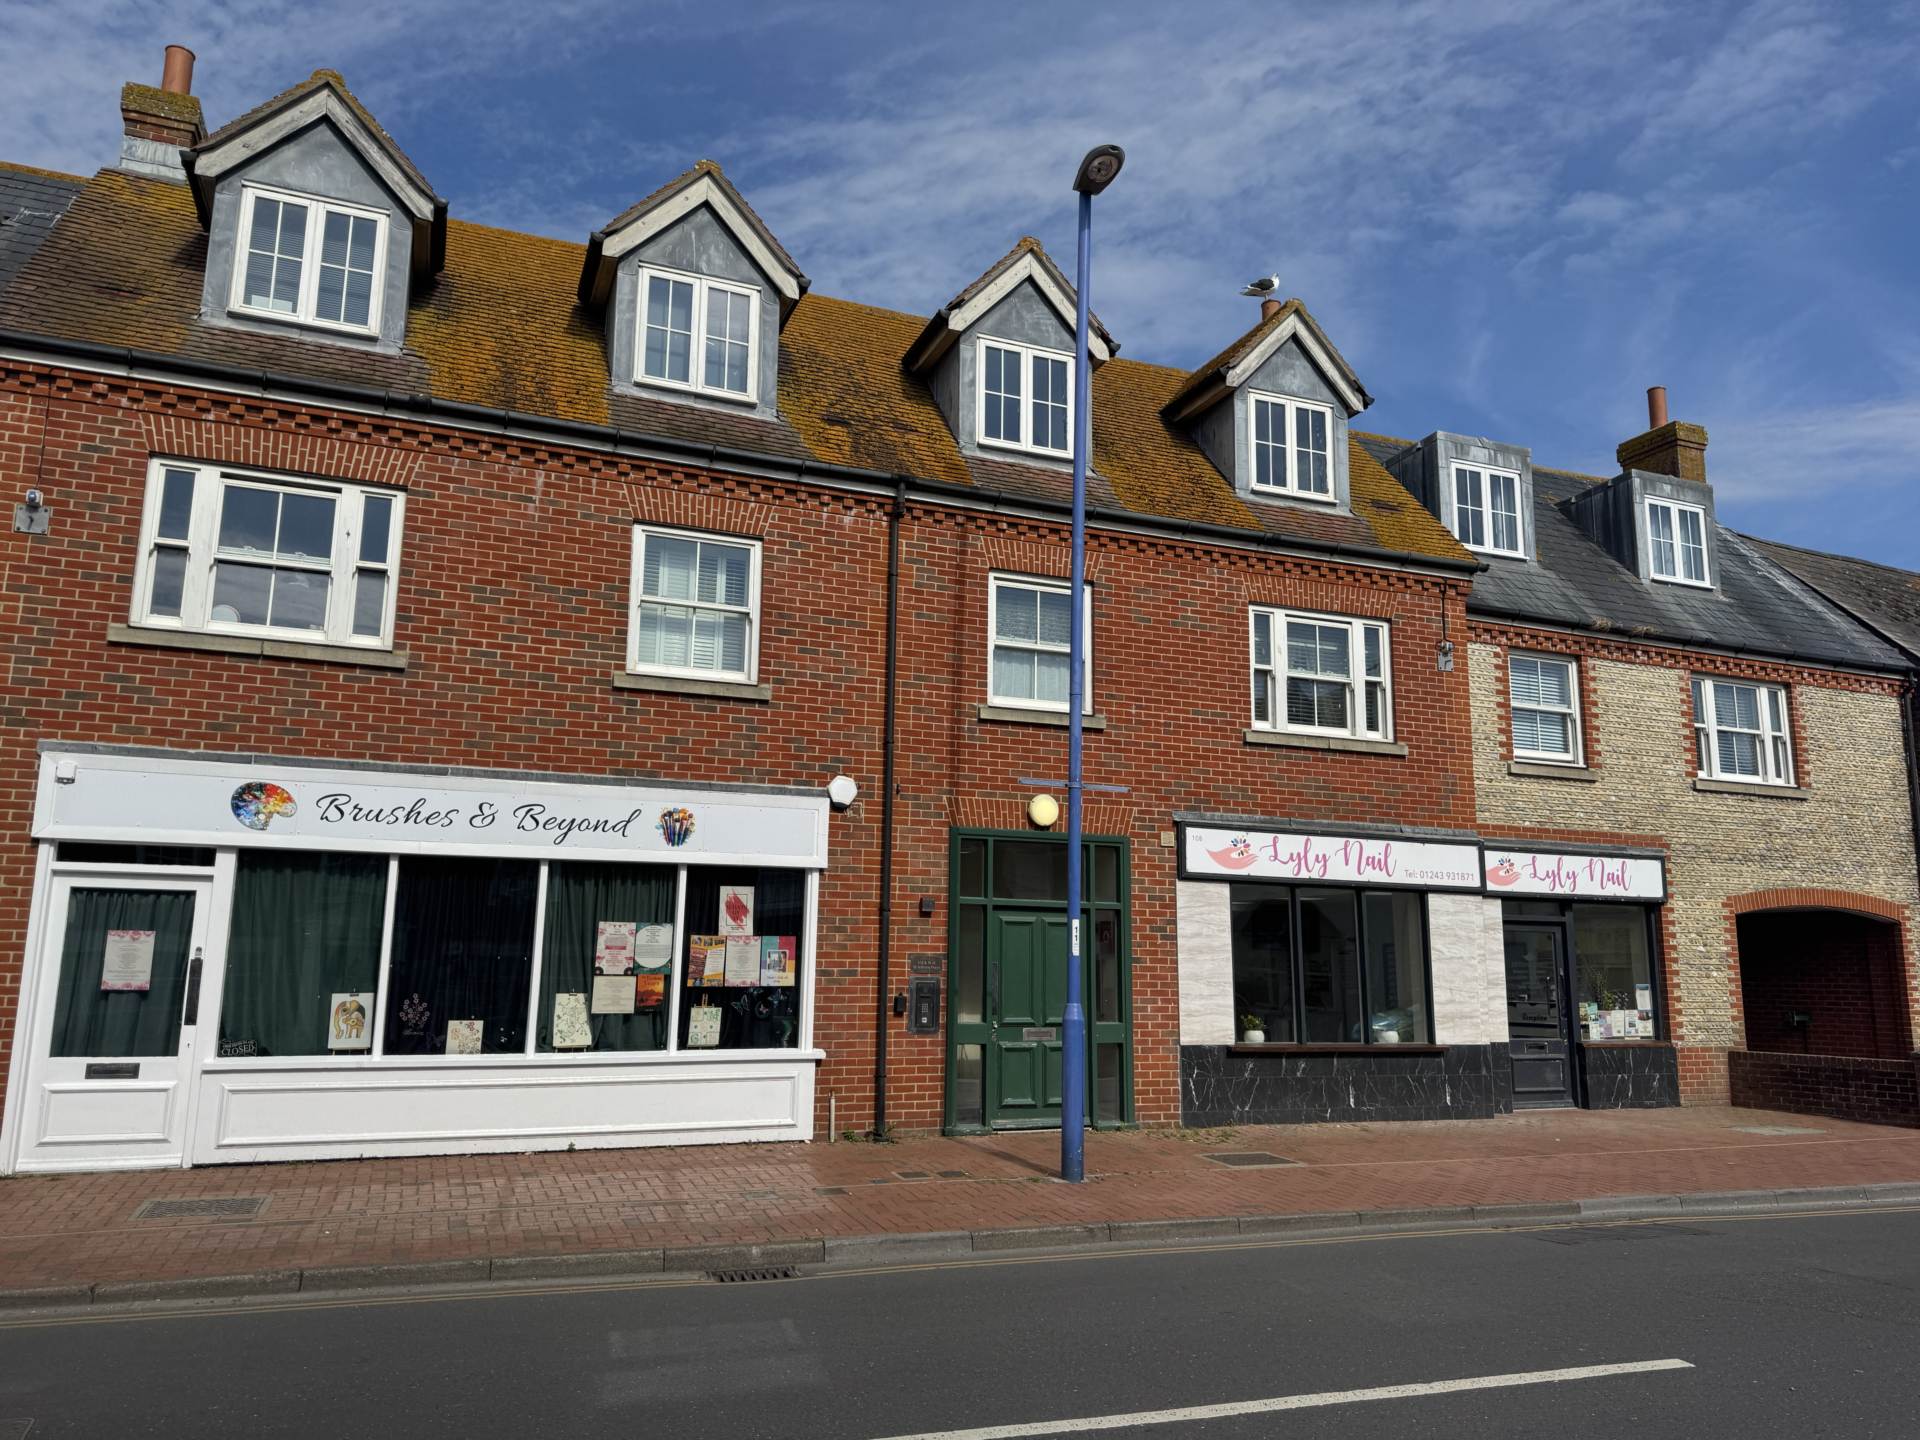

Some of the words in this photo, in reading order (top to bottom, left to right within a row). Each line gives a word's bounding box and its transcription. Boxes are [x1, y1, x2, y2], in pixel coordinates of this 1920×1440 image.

[315, 793, 460, 828] Brushes
[469, 801, 499, 828] &
[512, 803, 642, 845] Beyond
[1259, 835, 1331, 878] Lyly
[1335, 839, 1397, 877] Nail
[1404, 869, 1418, 879] Tel:
[1419, 870, 1444, 880] 01243
[1521, 855, 1580, 893] Lyly
[1582, 857, 1632, 892] Nail
